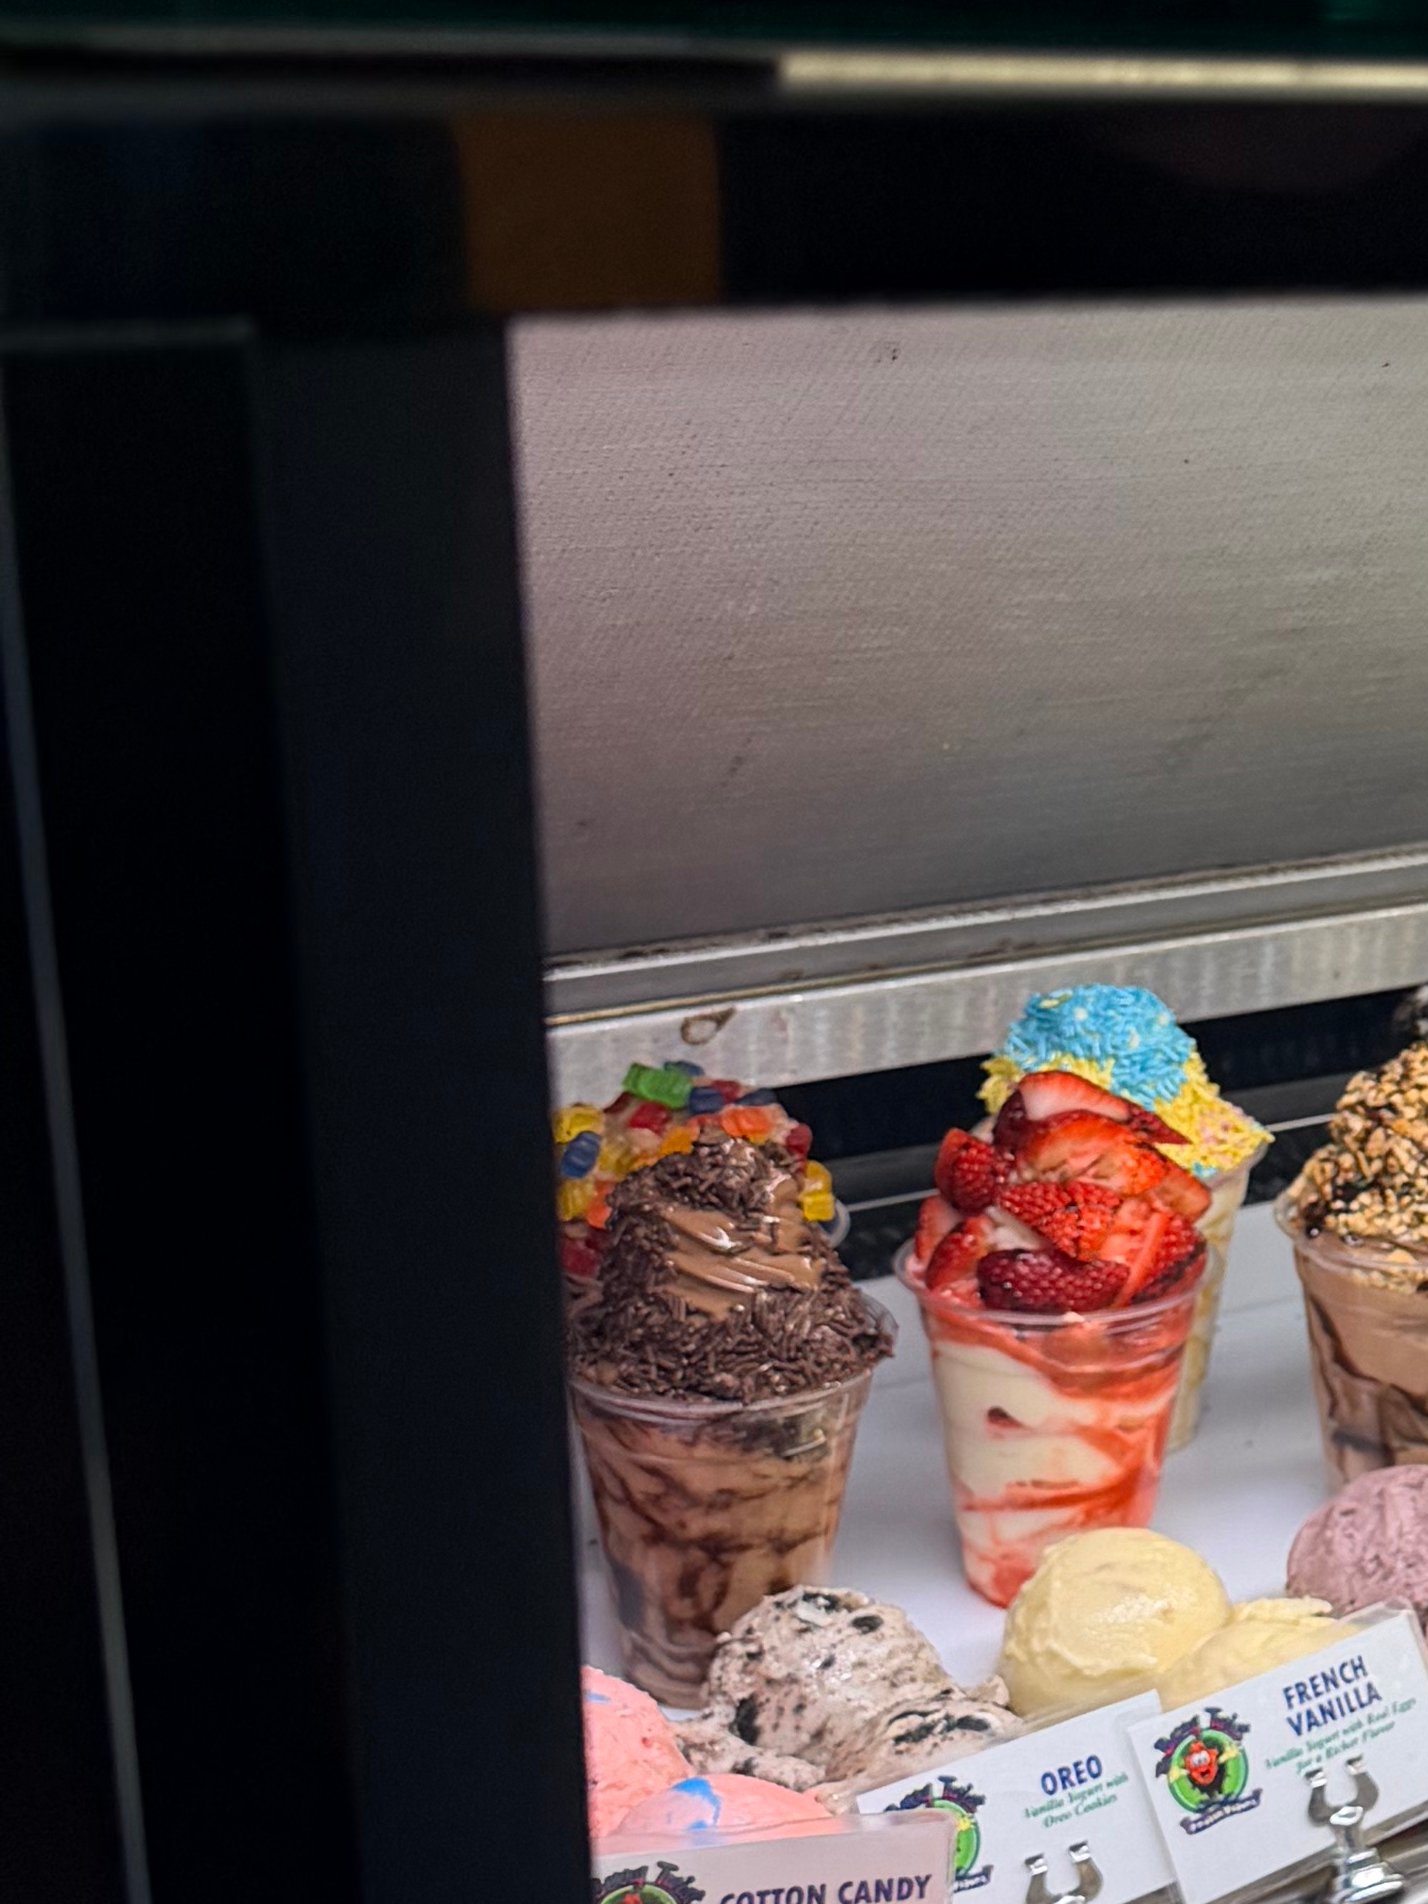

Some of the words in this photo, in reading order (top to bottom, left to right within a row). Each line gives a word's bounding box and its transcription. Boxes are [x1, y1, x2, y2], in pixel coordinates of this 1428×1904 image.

[1282, 1655, 1367, 1710] FRENCH
[1286, 1681, 1382, 1737] VANILLA
[1040, 1754, 1102, 1797] OREO
